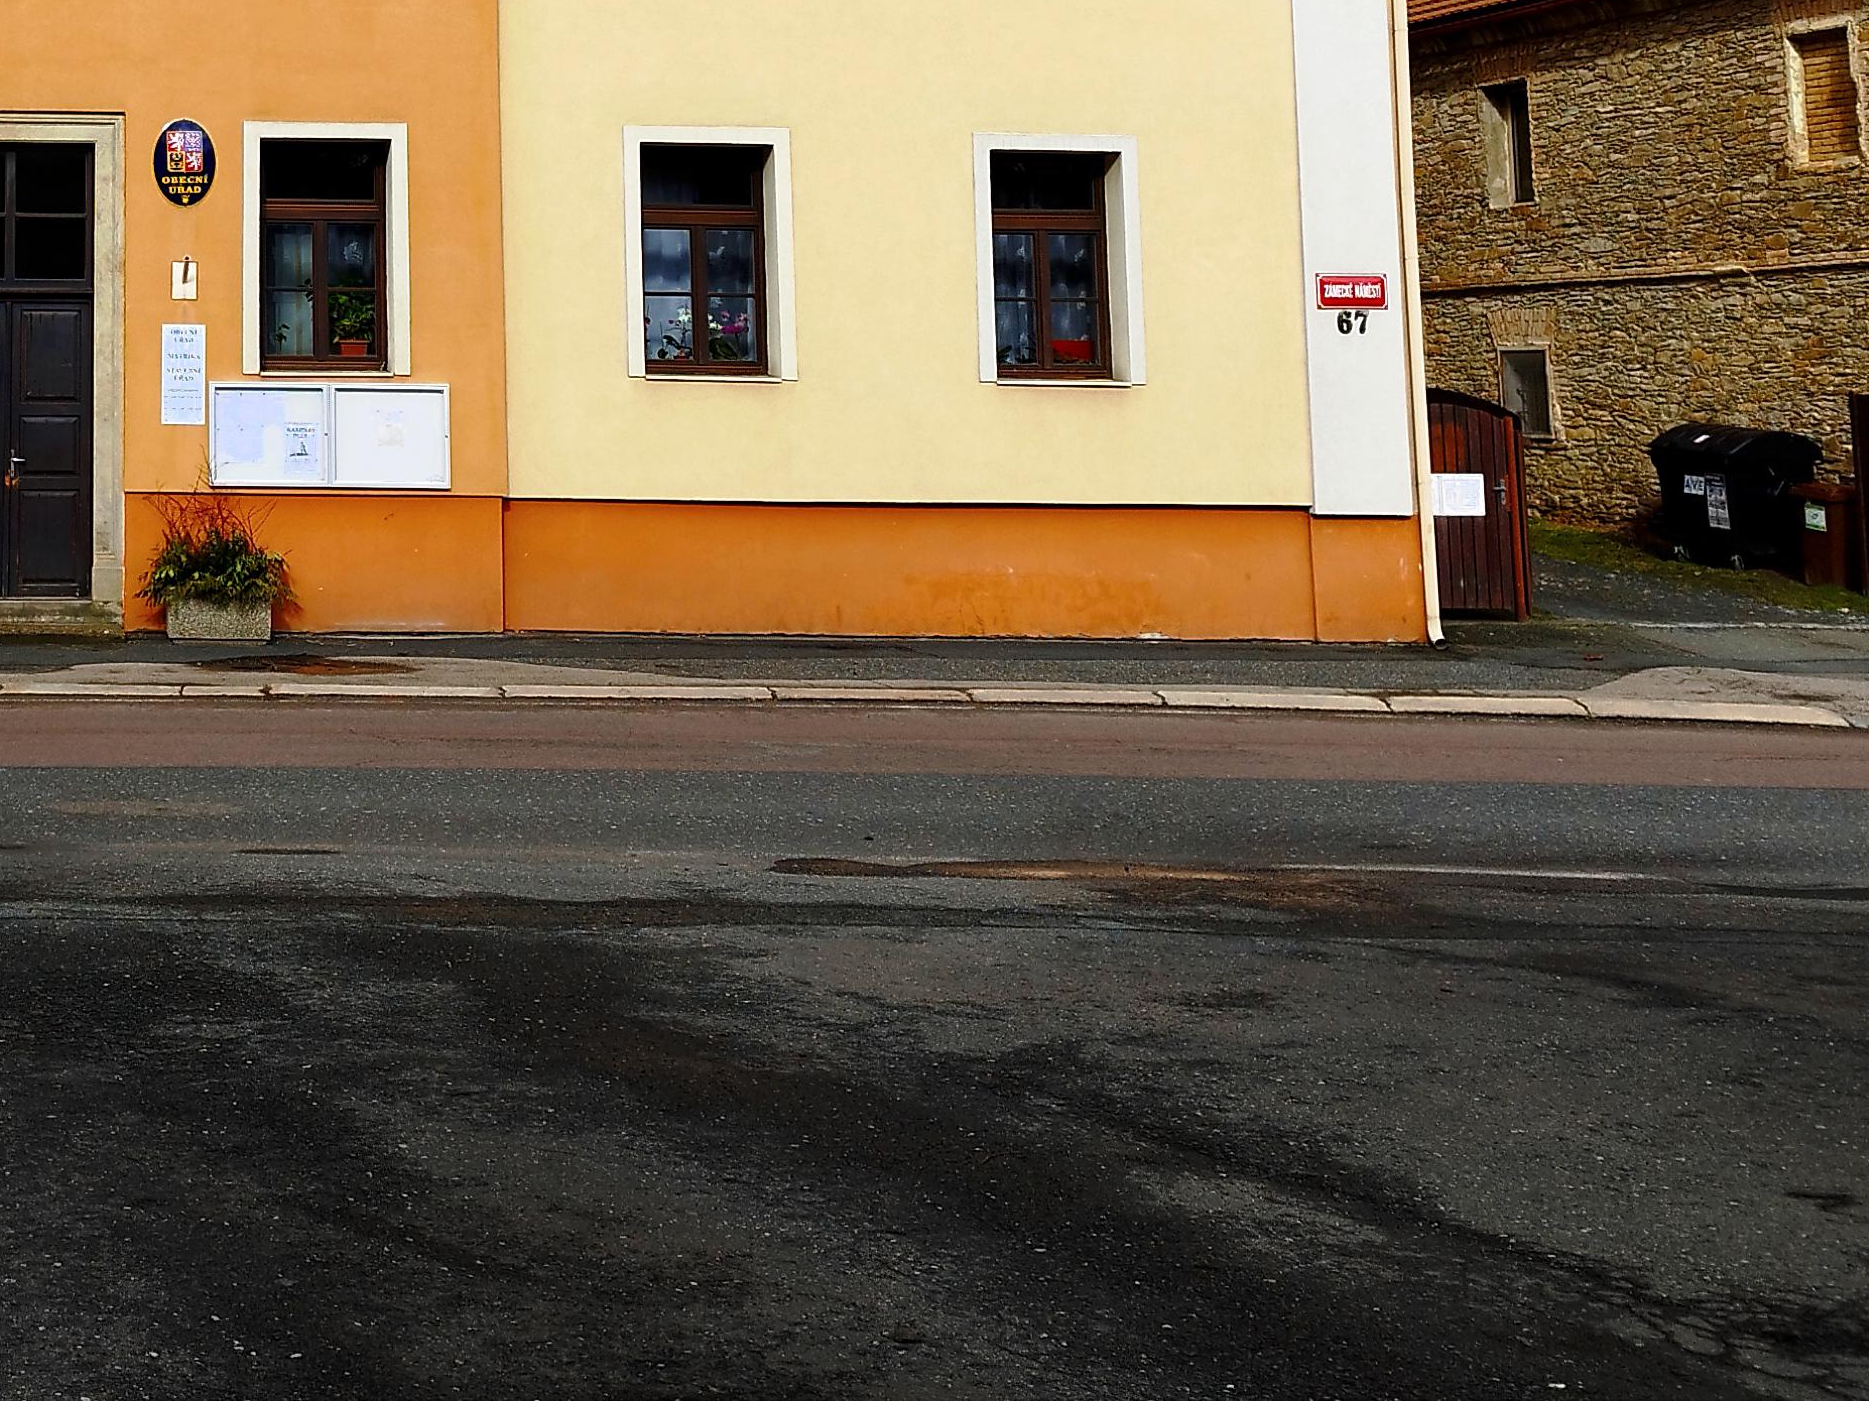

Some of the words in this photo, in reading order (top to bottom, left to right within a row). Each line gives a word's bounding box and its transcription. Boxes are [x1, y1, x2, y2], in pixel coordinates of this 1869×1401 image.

[161, 174, 208, 185] OBECNÍ
[1324, 282, 1353, 298] ZÁMECKÉ
[1354, 282, 1382, 299] NÁMĚSTÍ
[1337, 310, 1369, 335] 67
